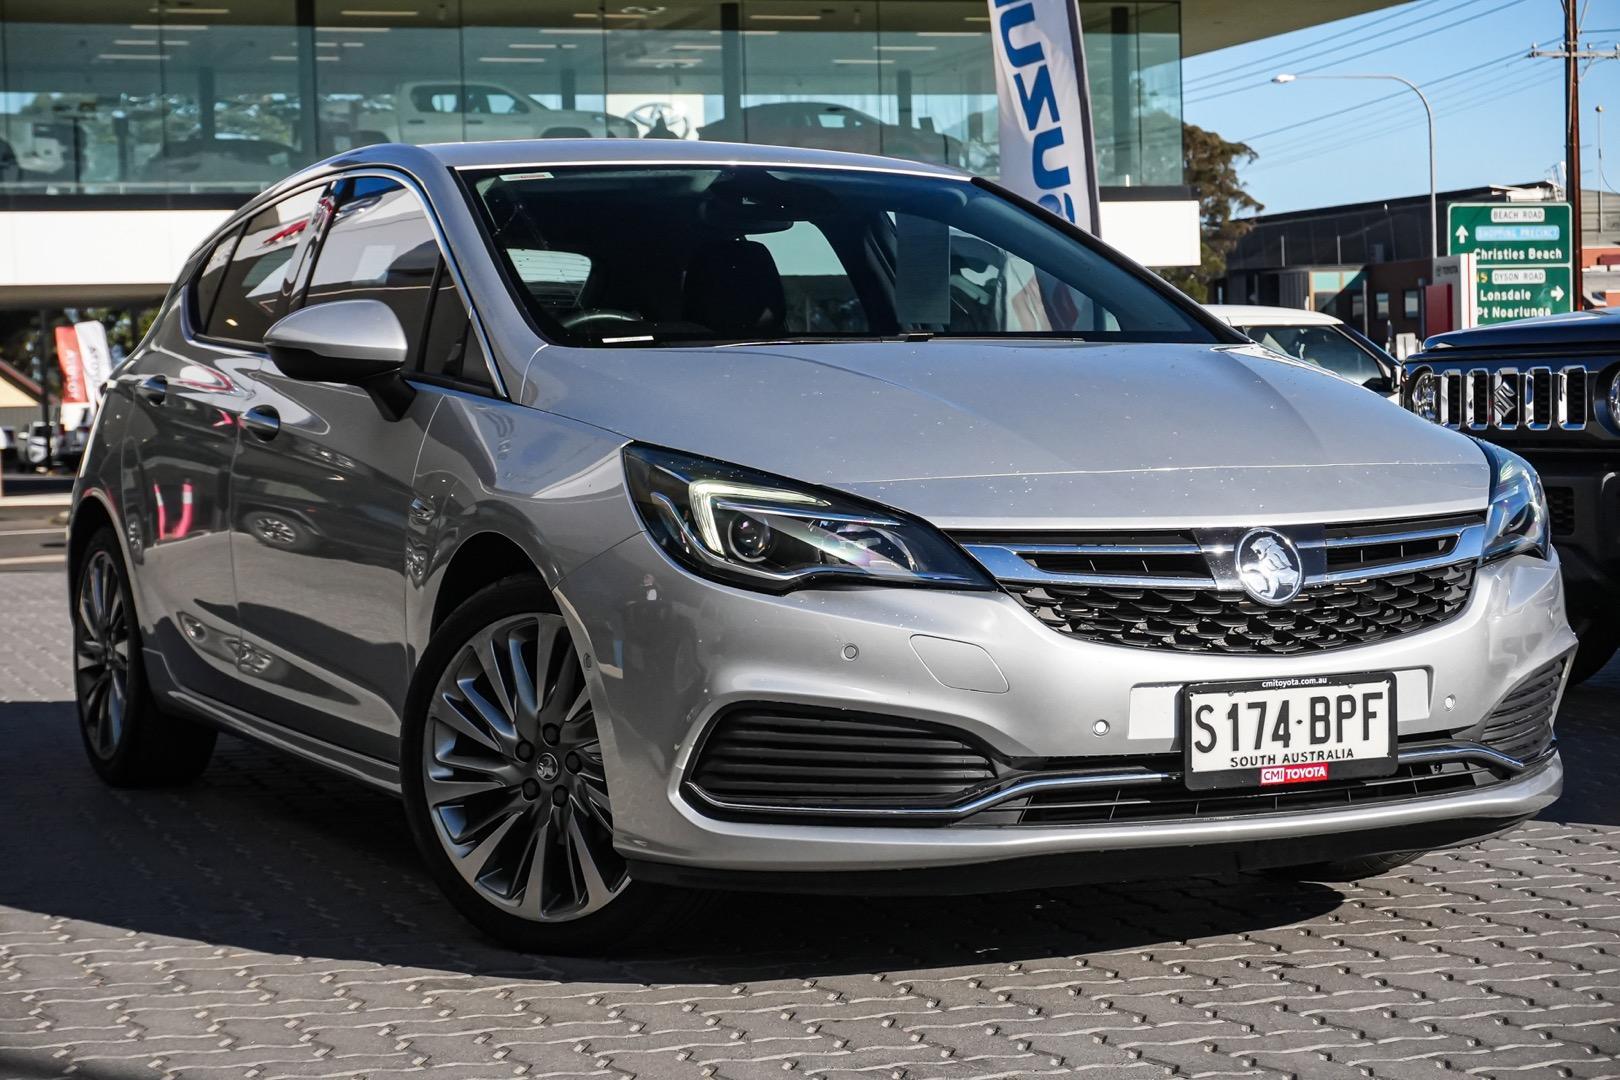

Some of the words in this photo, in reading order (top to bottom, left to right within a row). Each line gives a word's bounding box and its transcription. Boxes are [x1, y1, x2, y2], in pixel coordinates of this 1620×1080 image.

[1493, 210, 1519, 219] BEACH
[1523, 209, 1543, 219] ROAD
[1473, 248, 1525, 260] Christies
[1528, 247, 1562, 260] Beach
[1494, 273, 1519, 282] DYSON
[1524, 272, 1544, 281] ROAD
[1480, 289, 1531, 301] Lonsdale
[1477, 306, 1488, 318] Pt
[1261, 677, 1328, 689] cmitoyota.com.au
[1230, 754, 1276, 768] SOUTH
[1282, 748, 1354, 765] AUSTRALIA
[1263, 770, 1284, 781] CMI
[1285, 765, 1327, 780] TOYOTA
